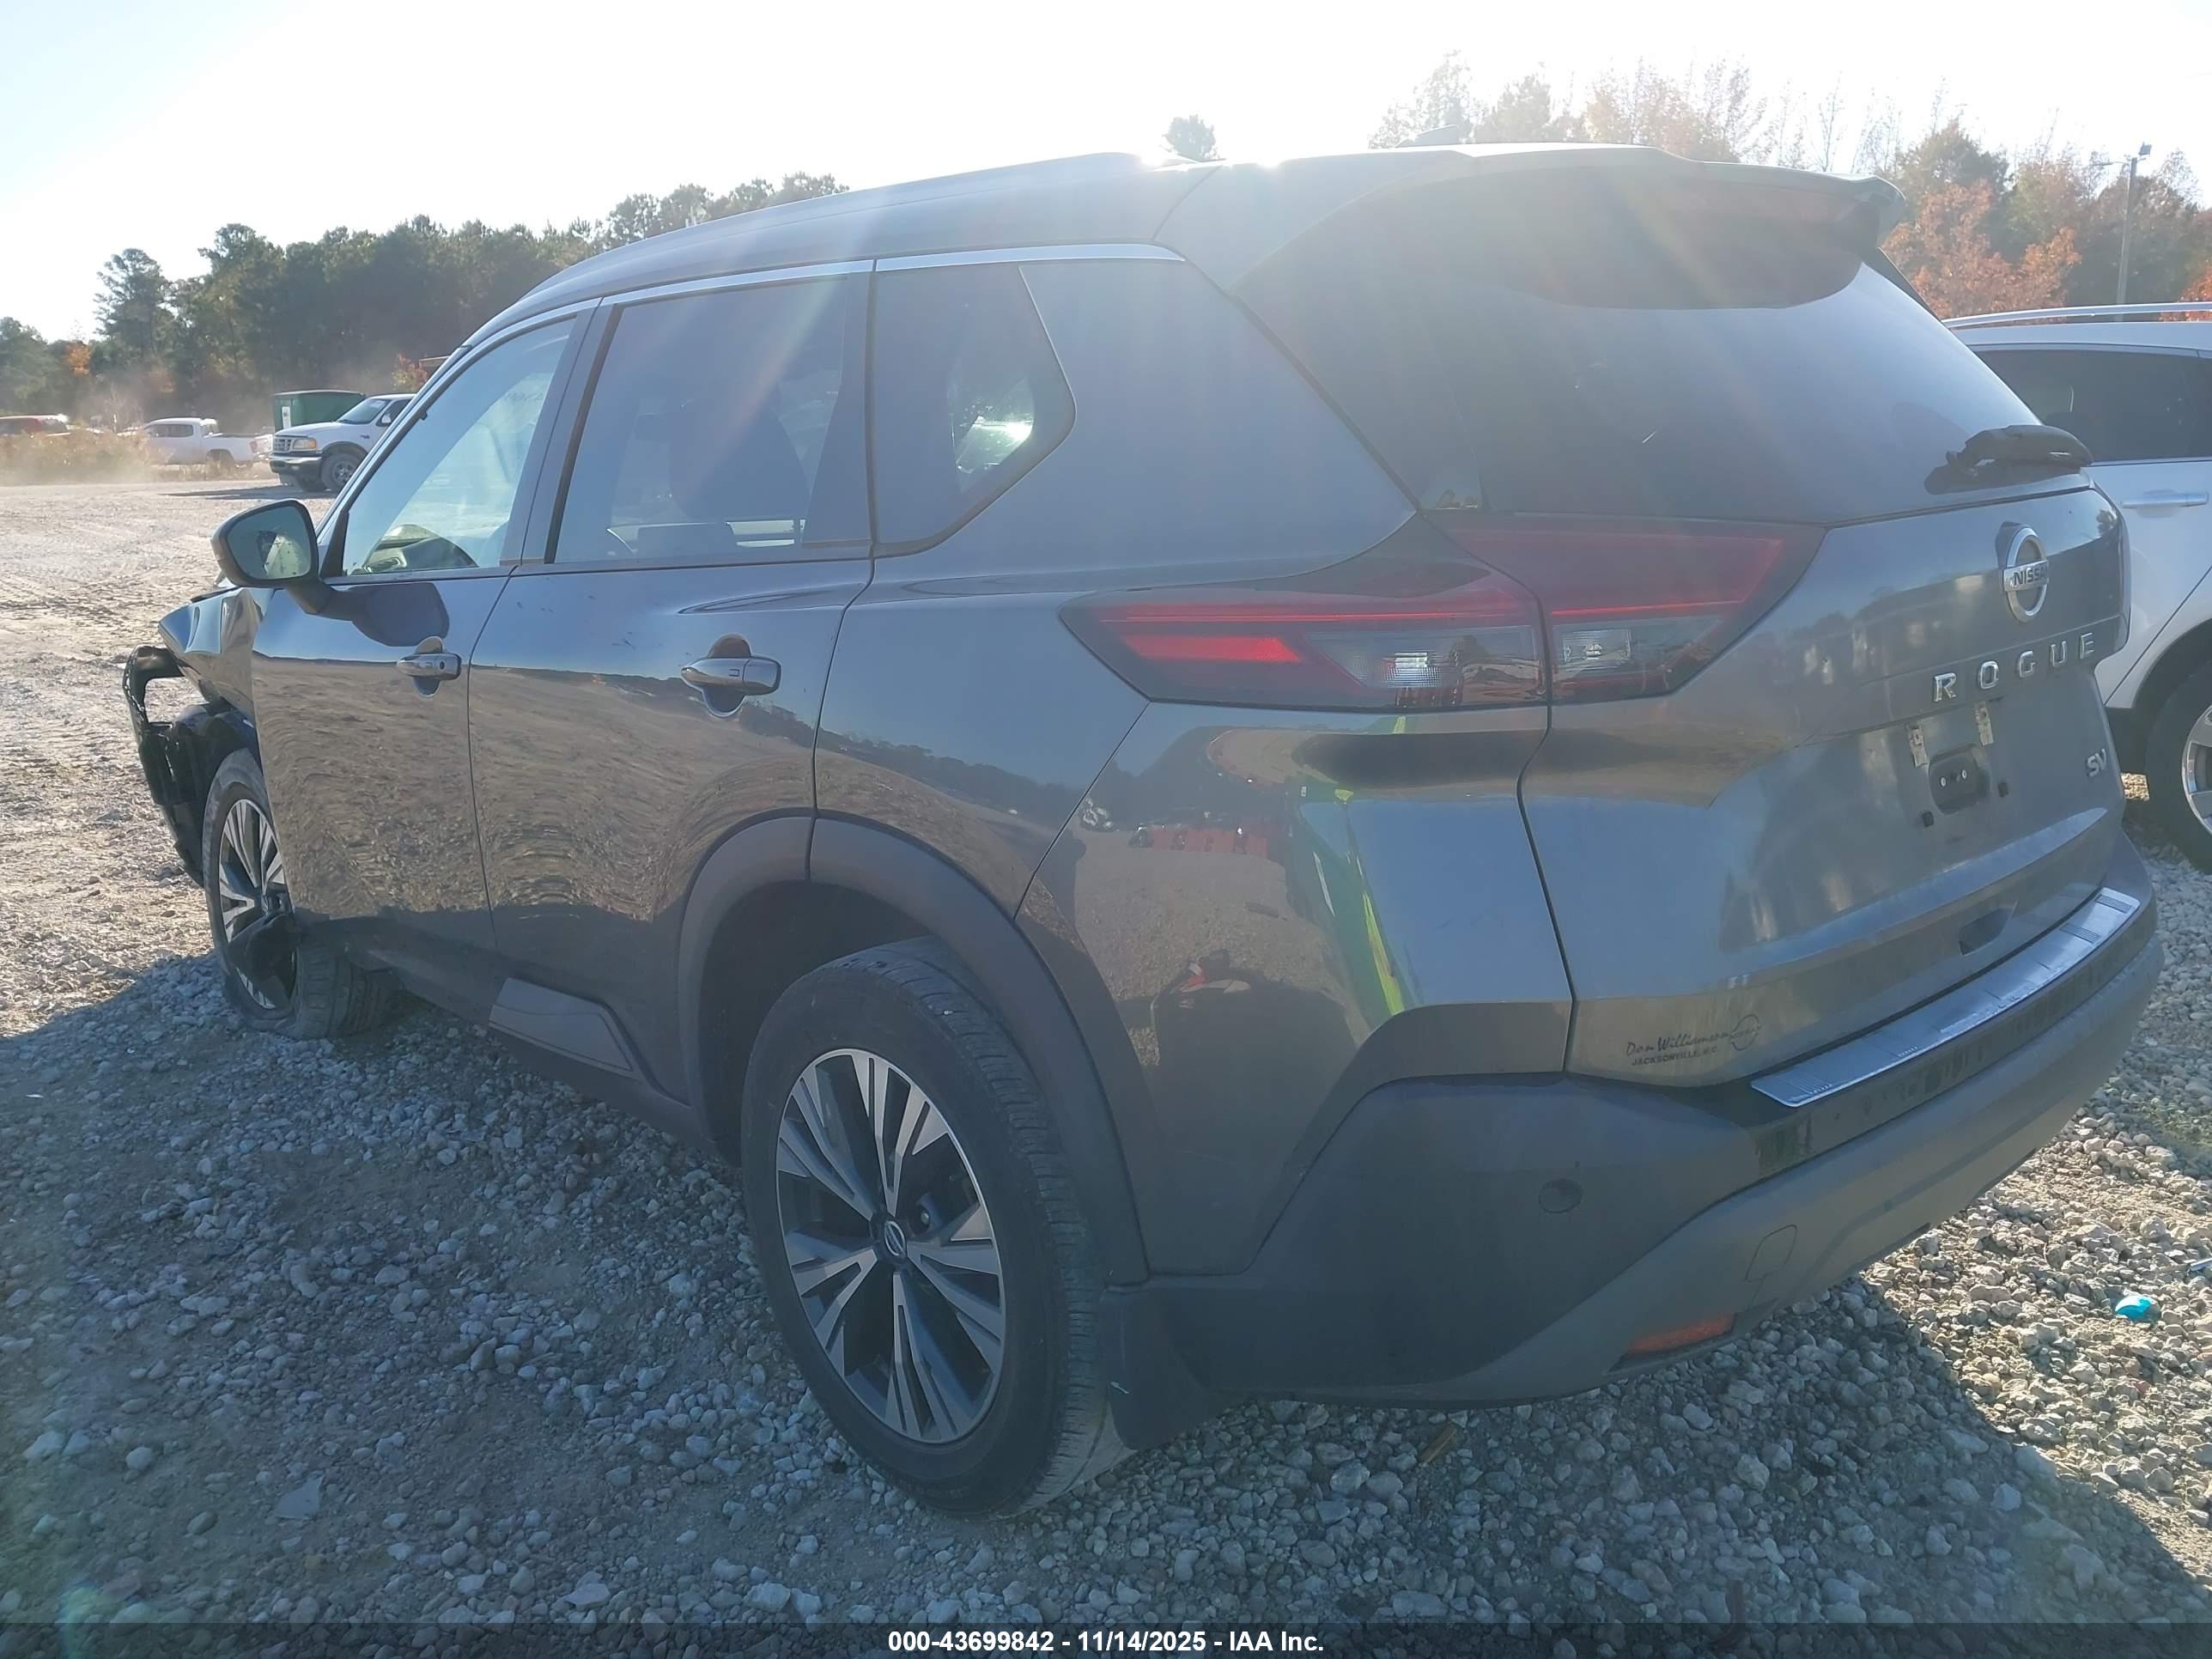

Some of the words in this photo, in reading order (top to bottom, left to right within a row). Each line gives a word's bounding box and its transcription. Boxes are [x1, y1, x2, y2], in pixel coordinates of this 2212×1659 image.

[2014, 566, 2047, 586] NISSA
[1933, 632, 2095, 702] ROGUE
[2086, 749, 2107, 778] SV
[1626, 1041, 1655, 1057] Don
[1657, 1033, 1729, 1052] Williamson
